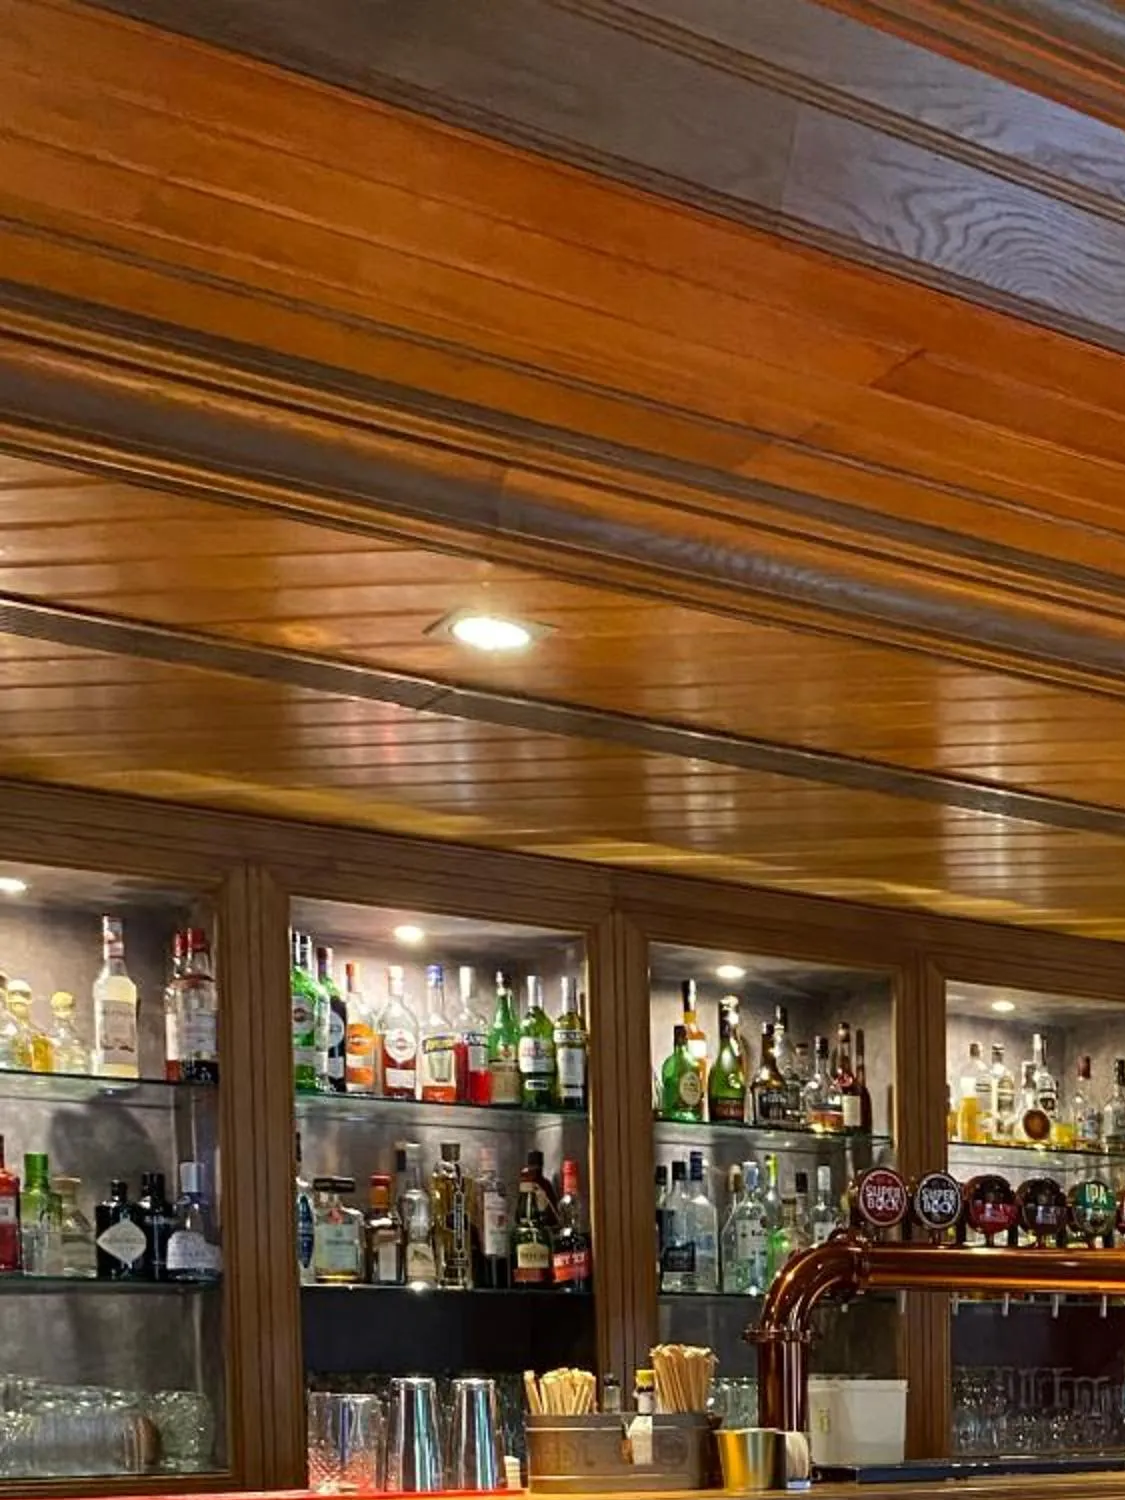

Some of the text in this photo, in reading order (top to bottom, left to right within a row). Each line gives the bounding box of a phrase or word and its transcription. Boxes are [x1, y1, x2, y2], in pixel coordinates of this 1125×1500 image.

[865, 1185, 901, 1198] SUPER
[921, 1187, 957, 1201] SUPER
[1085, 1183, 1107, 1204] IPA
[867, 1197, 899, 1211] BOCK
